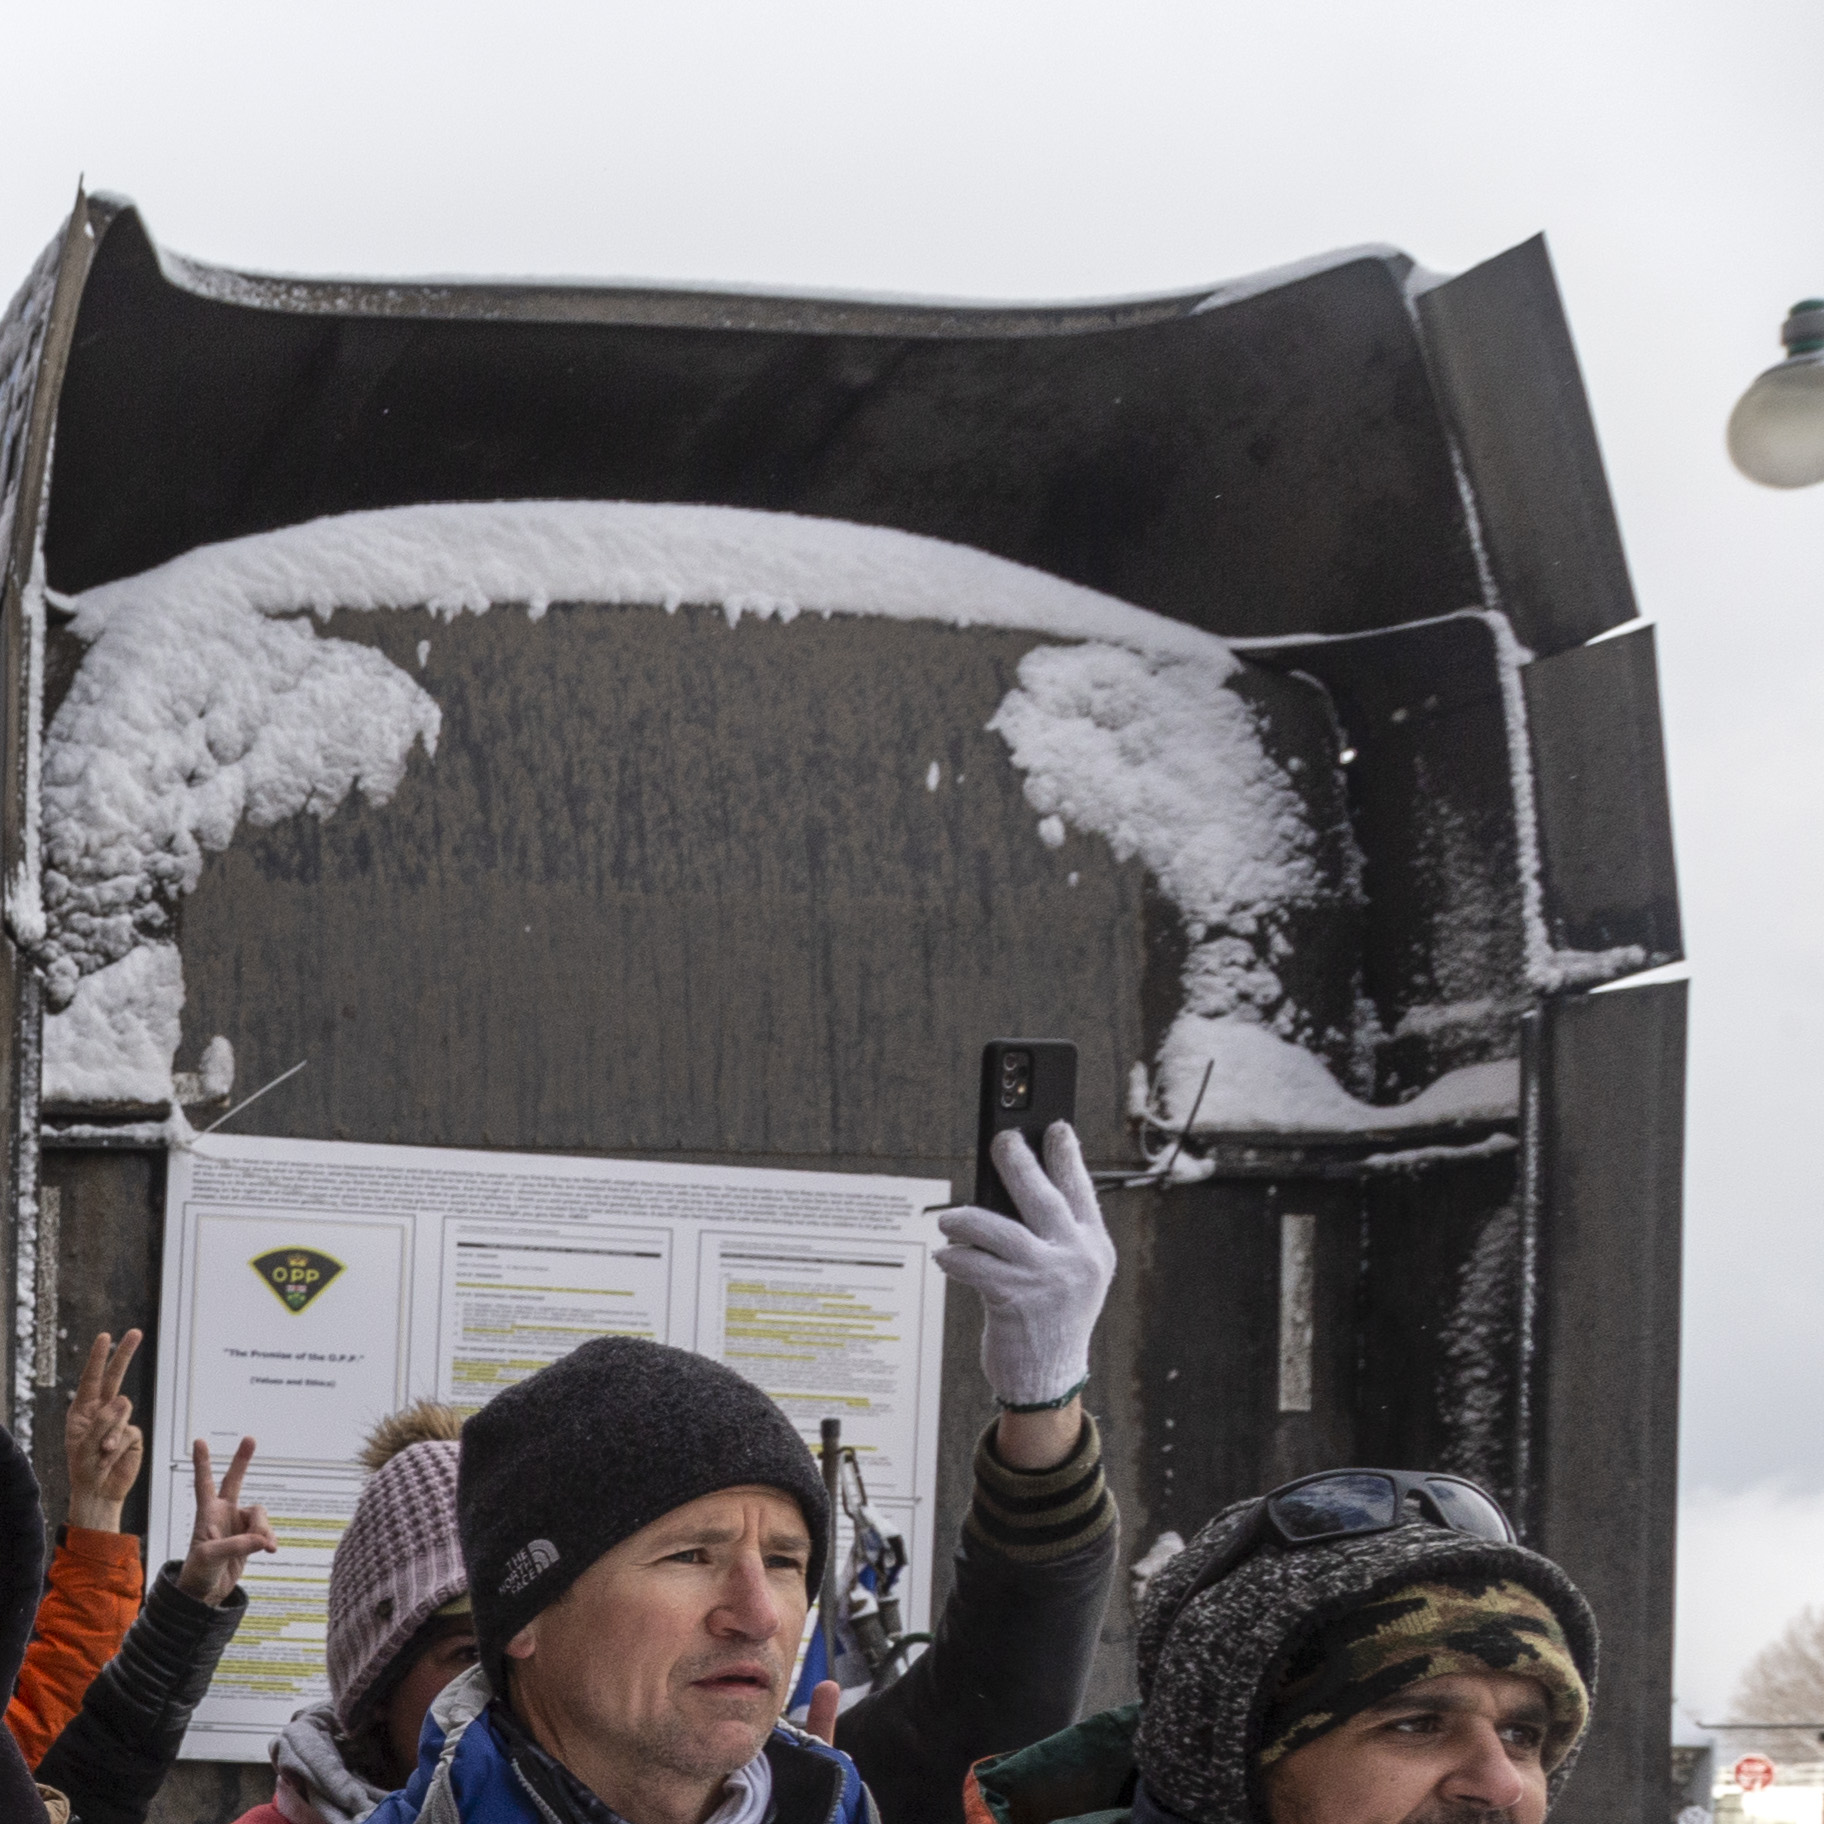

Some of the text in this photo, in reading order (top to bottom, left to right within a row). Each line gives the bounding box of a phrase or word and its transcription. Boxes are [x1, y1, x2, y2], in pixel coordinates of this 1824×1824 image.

[272, 1266, 320, 1283] OPP
[251, 1350, 292, 1360] Promise
[295, 1353, 306, 1361] of
[308, 1352, 325, 1361] the
[505, 1547, 528, 1571] THE
[498, 1560, 532, 1595] NORTH
[511, 1568, 537, 1594] FACE
